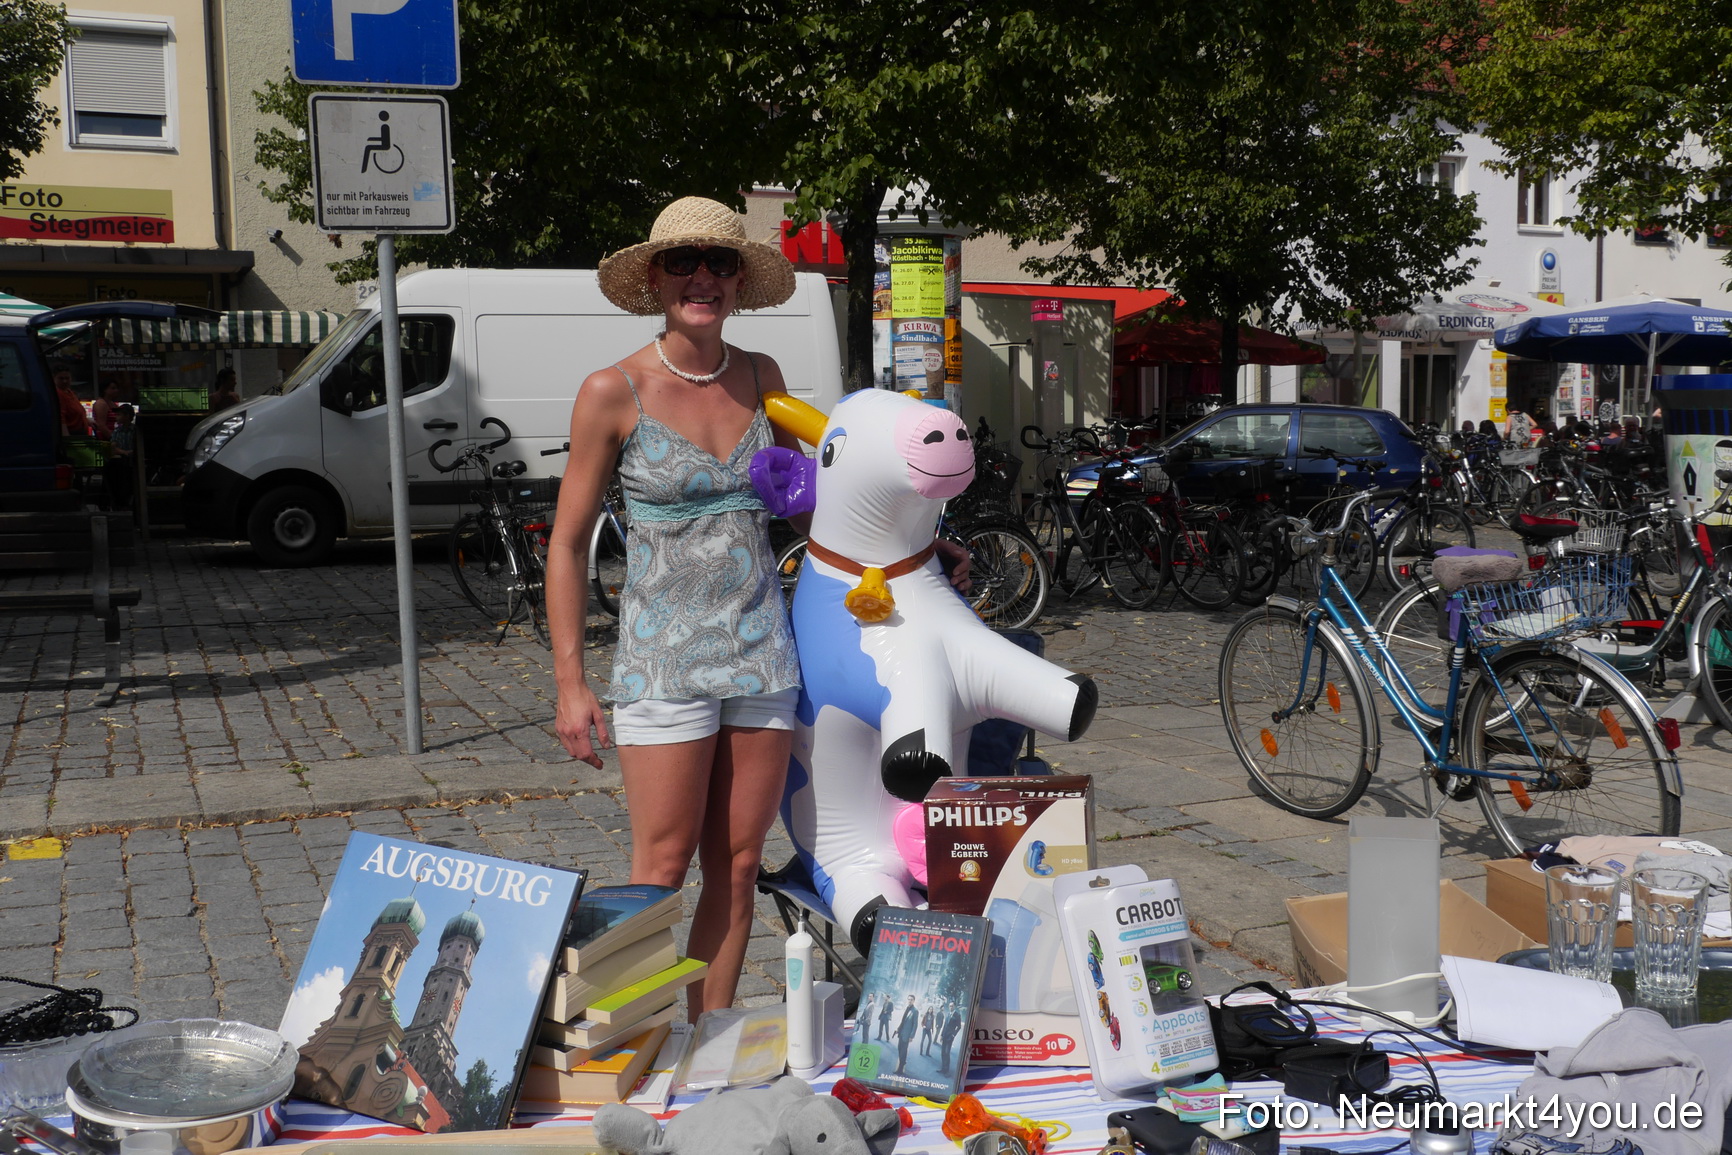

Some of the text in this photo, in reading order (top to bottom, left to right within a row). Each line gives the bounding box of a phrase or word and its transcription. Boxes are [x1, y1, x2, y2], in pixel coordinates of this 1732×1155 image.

[1, 186, 63, 208] Foto
[326, 191, 409, 202] nur mit Parkausweis
[326, 205, 411, 217] sichtbar im Fahrzeug
[29, 212, 167, 240] Stegmeier
[892, 246, 943, 255] Jacobikirwa
[928, 255, 943, 263] Heng
[904, 322, 937, 333] KIRWA
[1439, 315, 1495, 330] ERDINGER
[1361, 653, 1386, 687] HERCULES
[928, 805, 1028, 827] PHILIPS
[953, 842, 985, 851] DOUWE
[951, 850, 989, 858] EGBERTS
[360, 843, 553, 907] AUGSBURG
[1116, 897, 1182, 926] CARBOT
[883, 915, 926, 924] LEONARDO
[878, 928, 972, 955] INCEPTION
[1152, 1011, 1207, 1033] AppBots
[974, 1028, 1034, 1041] nseo
[1046, 1041, 1057, 1051] 10
[859, 1057, 871, 1068] 12
[1151, 1062, 1160, 1074] 4
